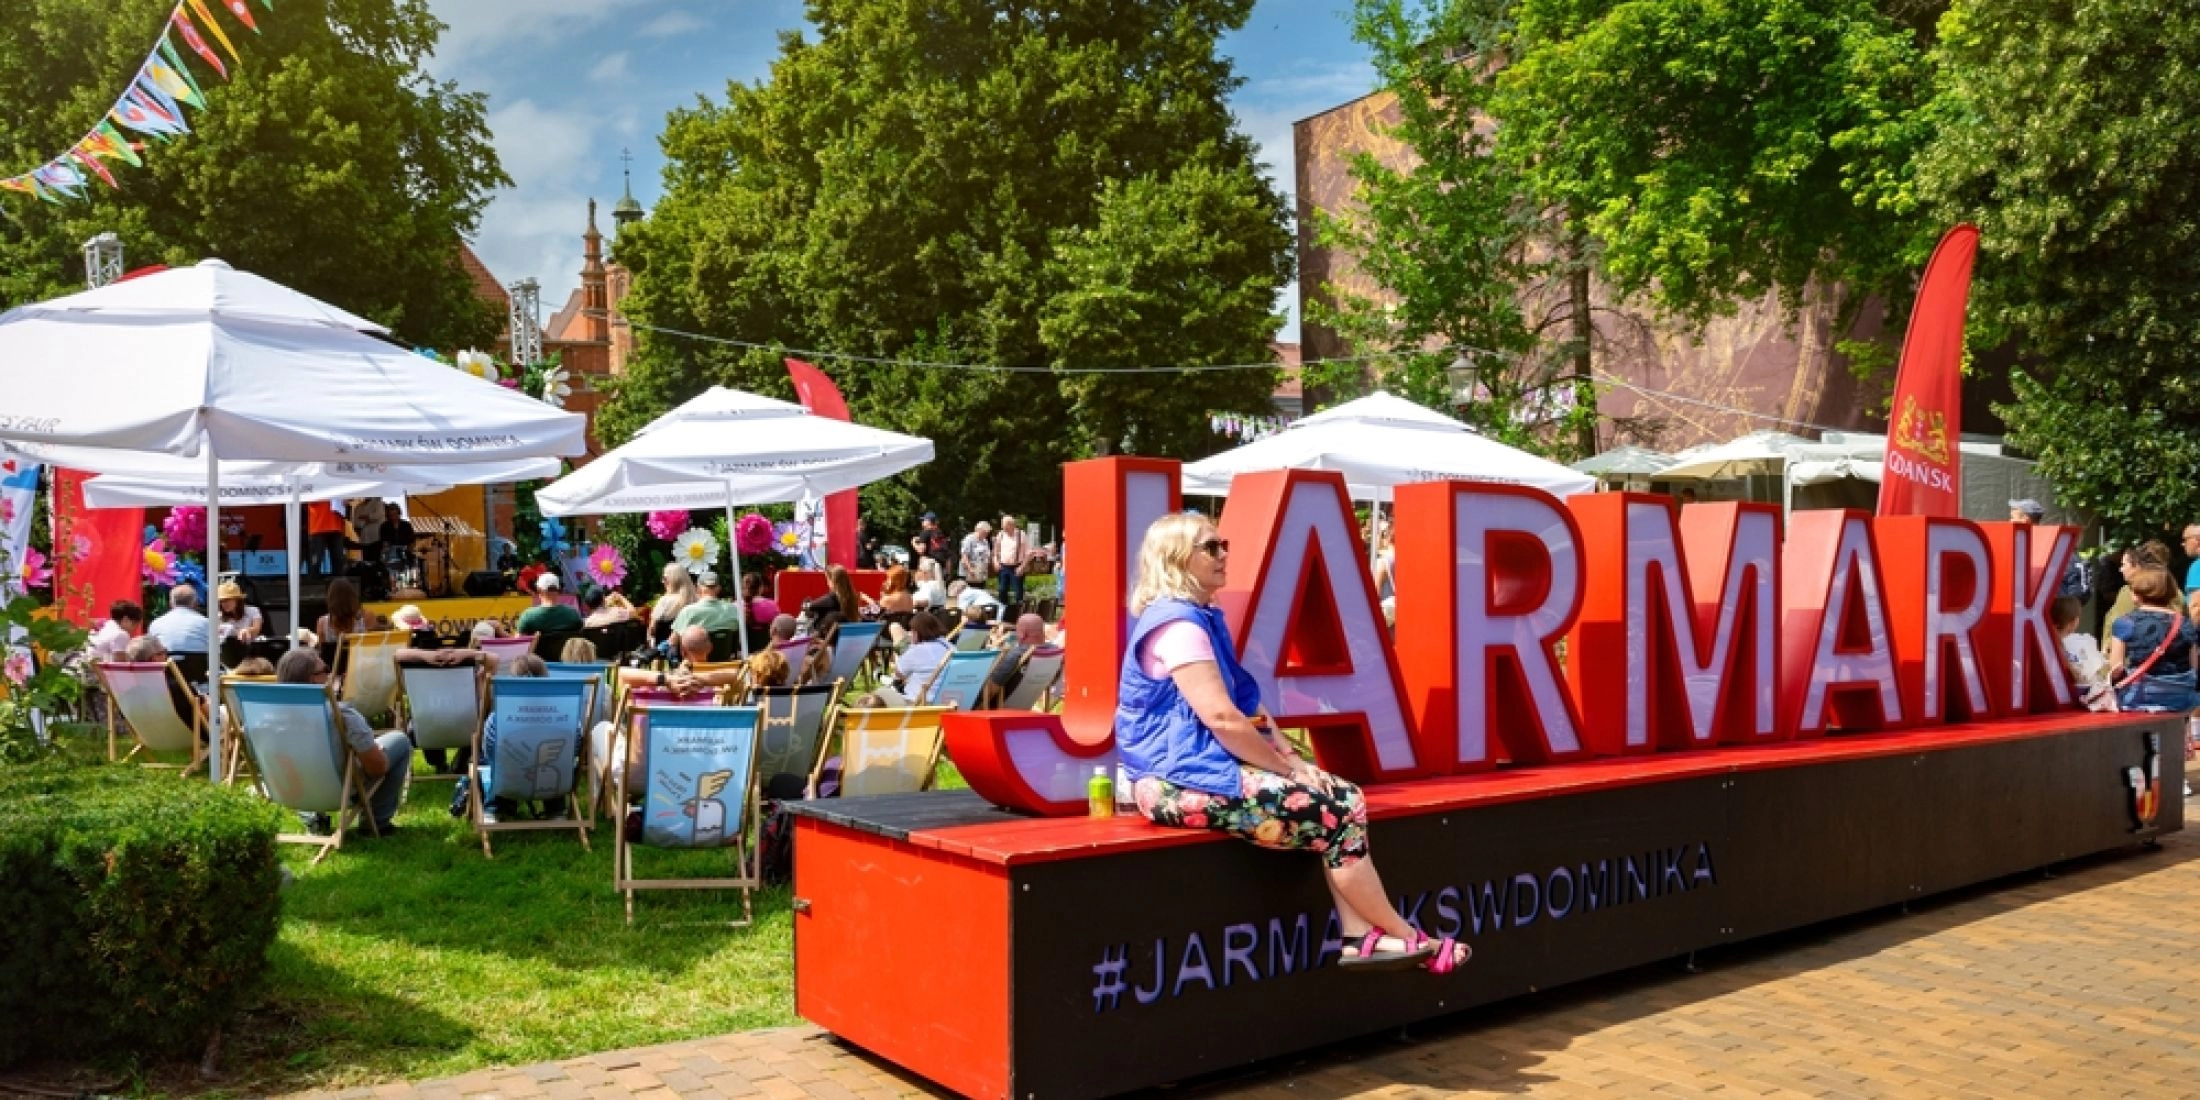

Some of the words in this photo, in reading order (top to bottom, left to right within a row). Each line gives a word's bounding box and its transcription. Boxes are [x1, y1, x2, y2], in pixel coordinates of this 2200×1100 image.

[1889, 450, 1953, 494] GDAŃSK
[943, 456, 2082, 820] JARMARK
[1092, 841, 1717, 1012] #JARMAKSWDOMINIKA
